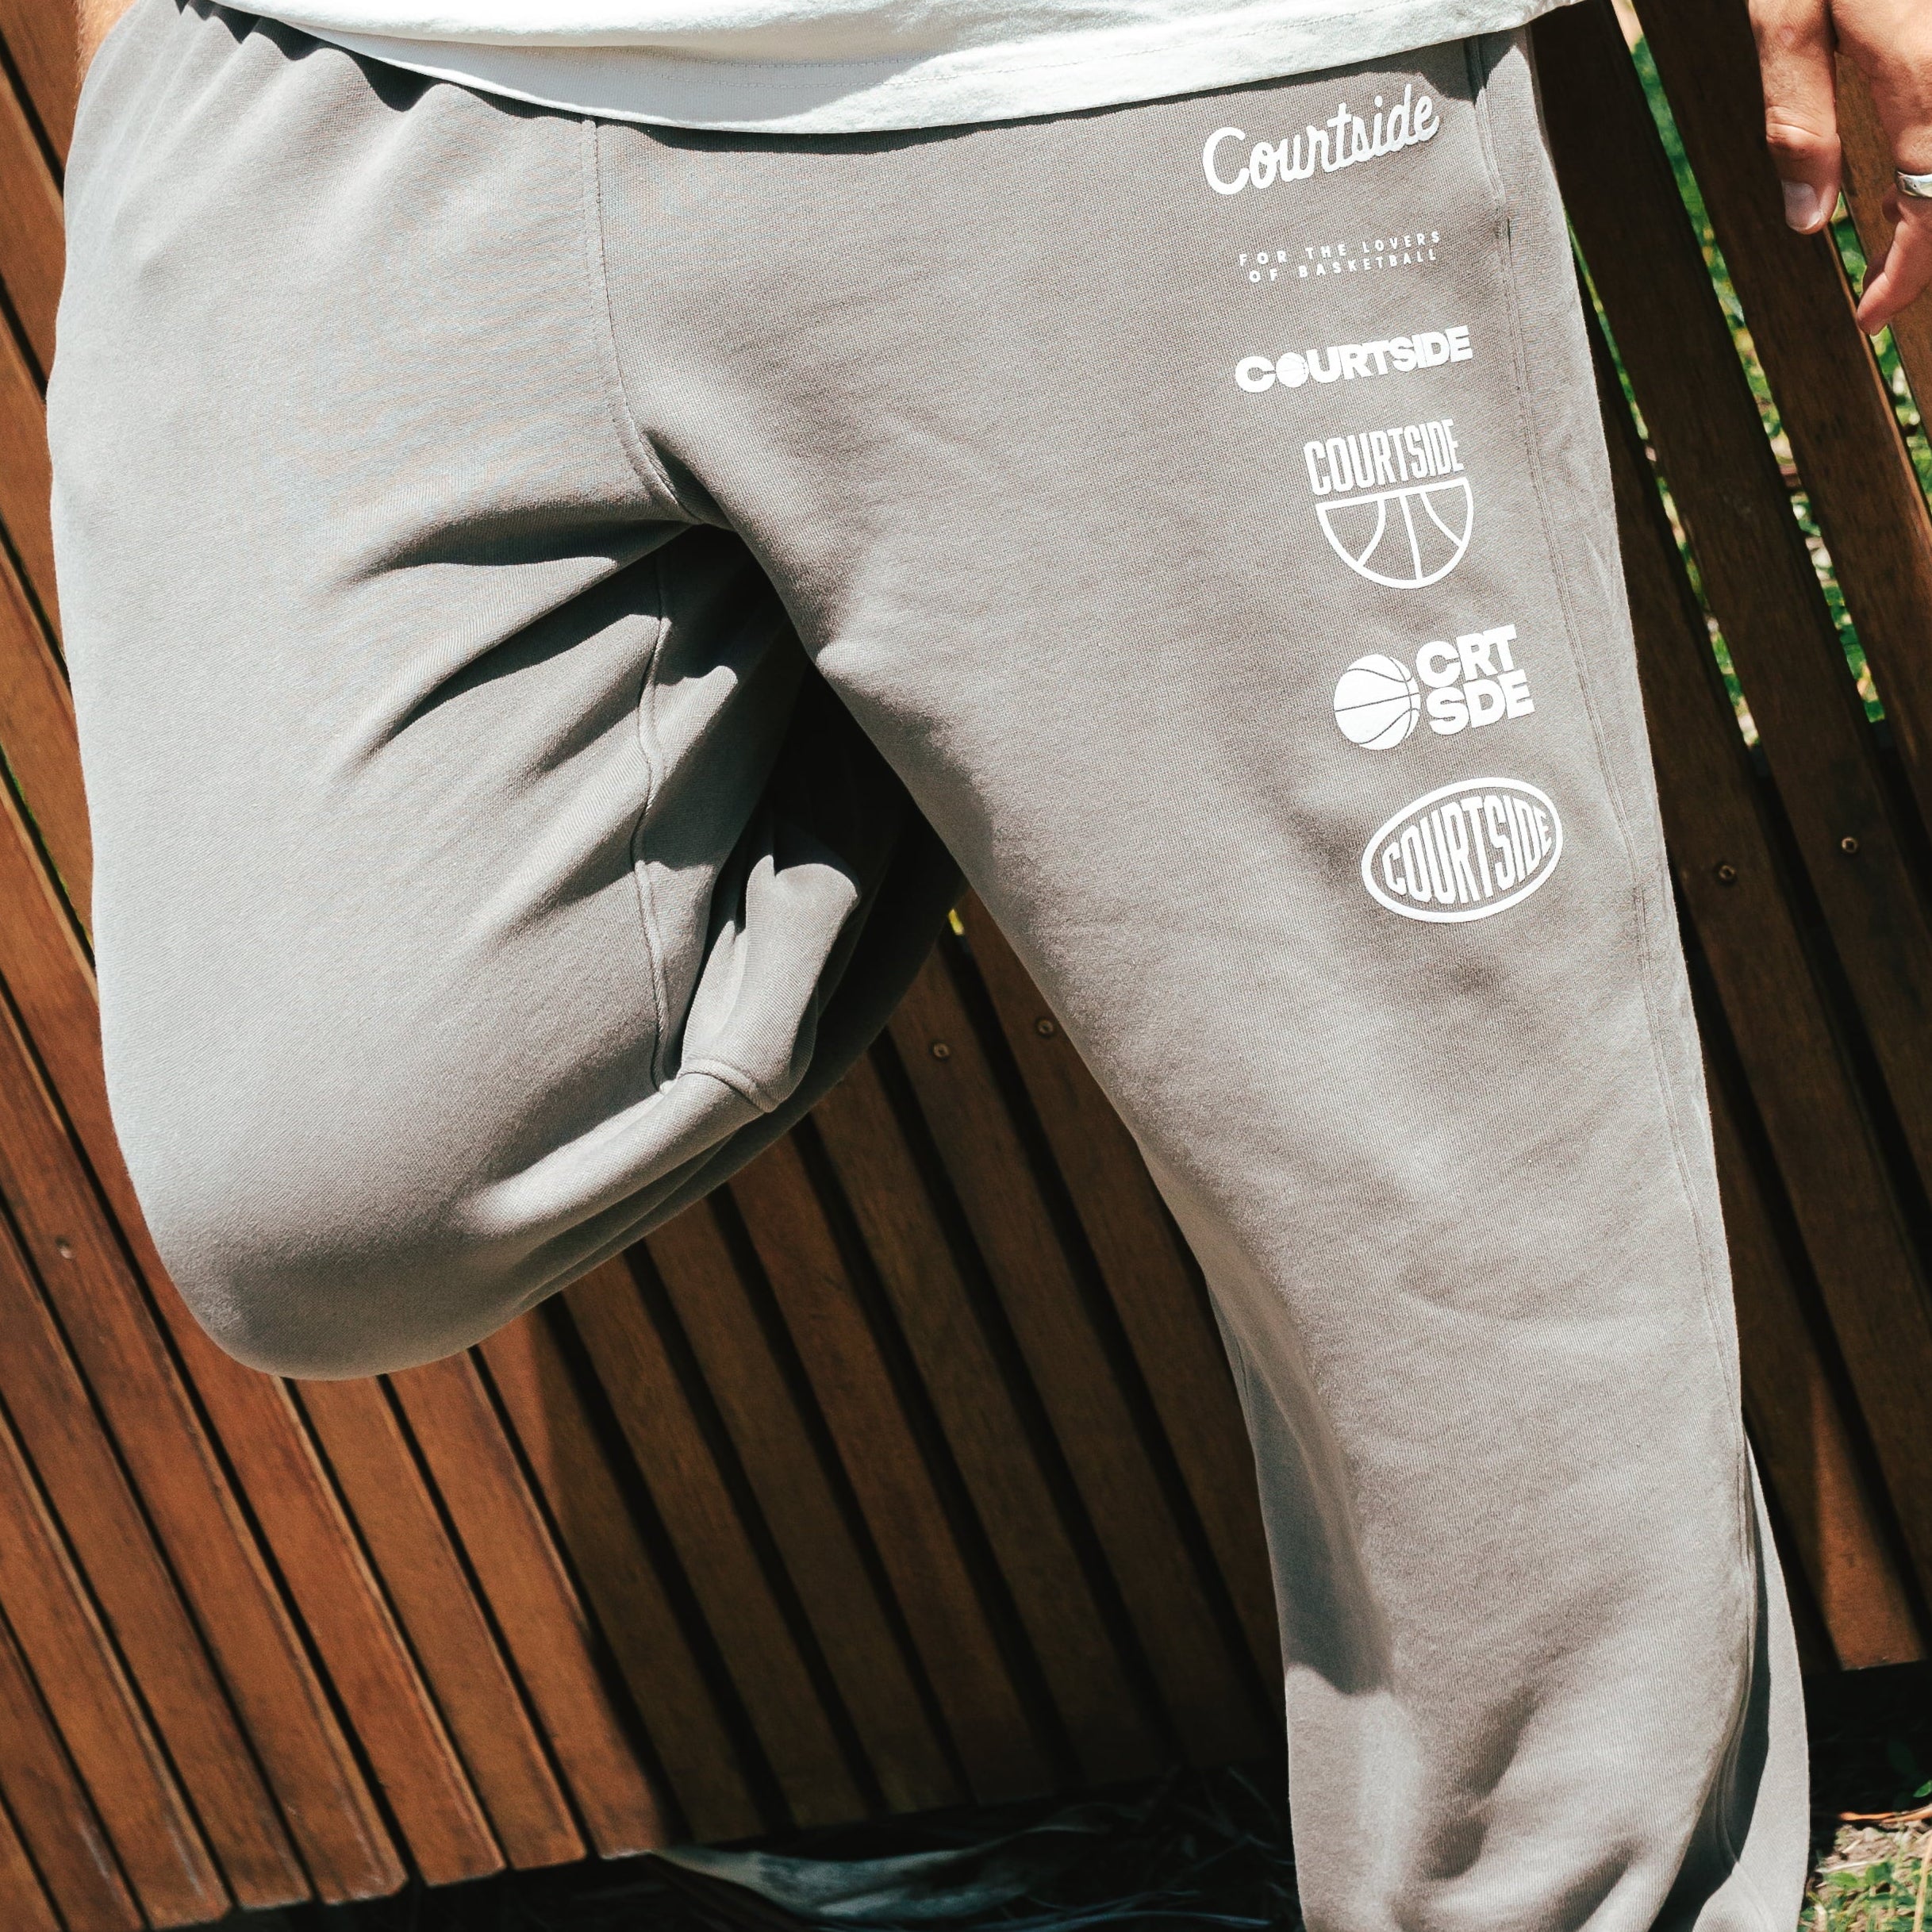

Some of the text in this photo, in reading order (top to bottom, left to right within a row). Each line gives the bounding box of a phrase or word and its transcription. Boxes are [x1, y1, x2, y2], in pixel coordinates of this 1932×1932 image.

[1202, 83, 1440, 195] Courtside
[1239, 230, 1441, 267] FOR THE LOVERS
[1248, 248, 1437, 283] OF BASKETBALL
[1234, 325, 1473, 394] COURTSIDE
[1303, 417, 1465, 496] COURTSIDE
[1415, 623, 1518, 688] CRT
[1426, 669, 1536, 736] SDE
[1381, 794, 1553, 905] COURTSIDE
